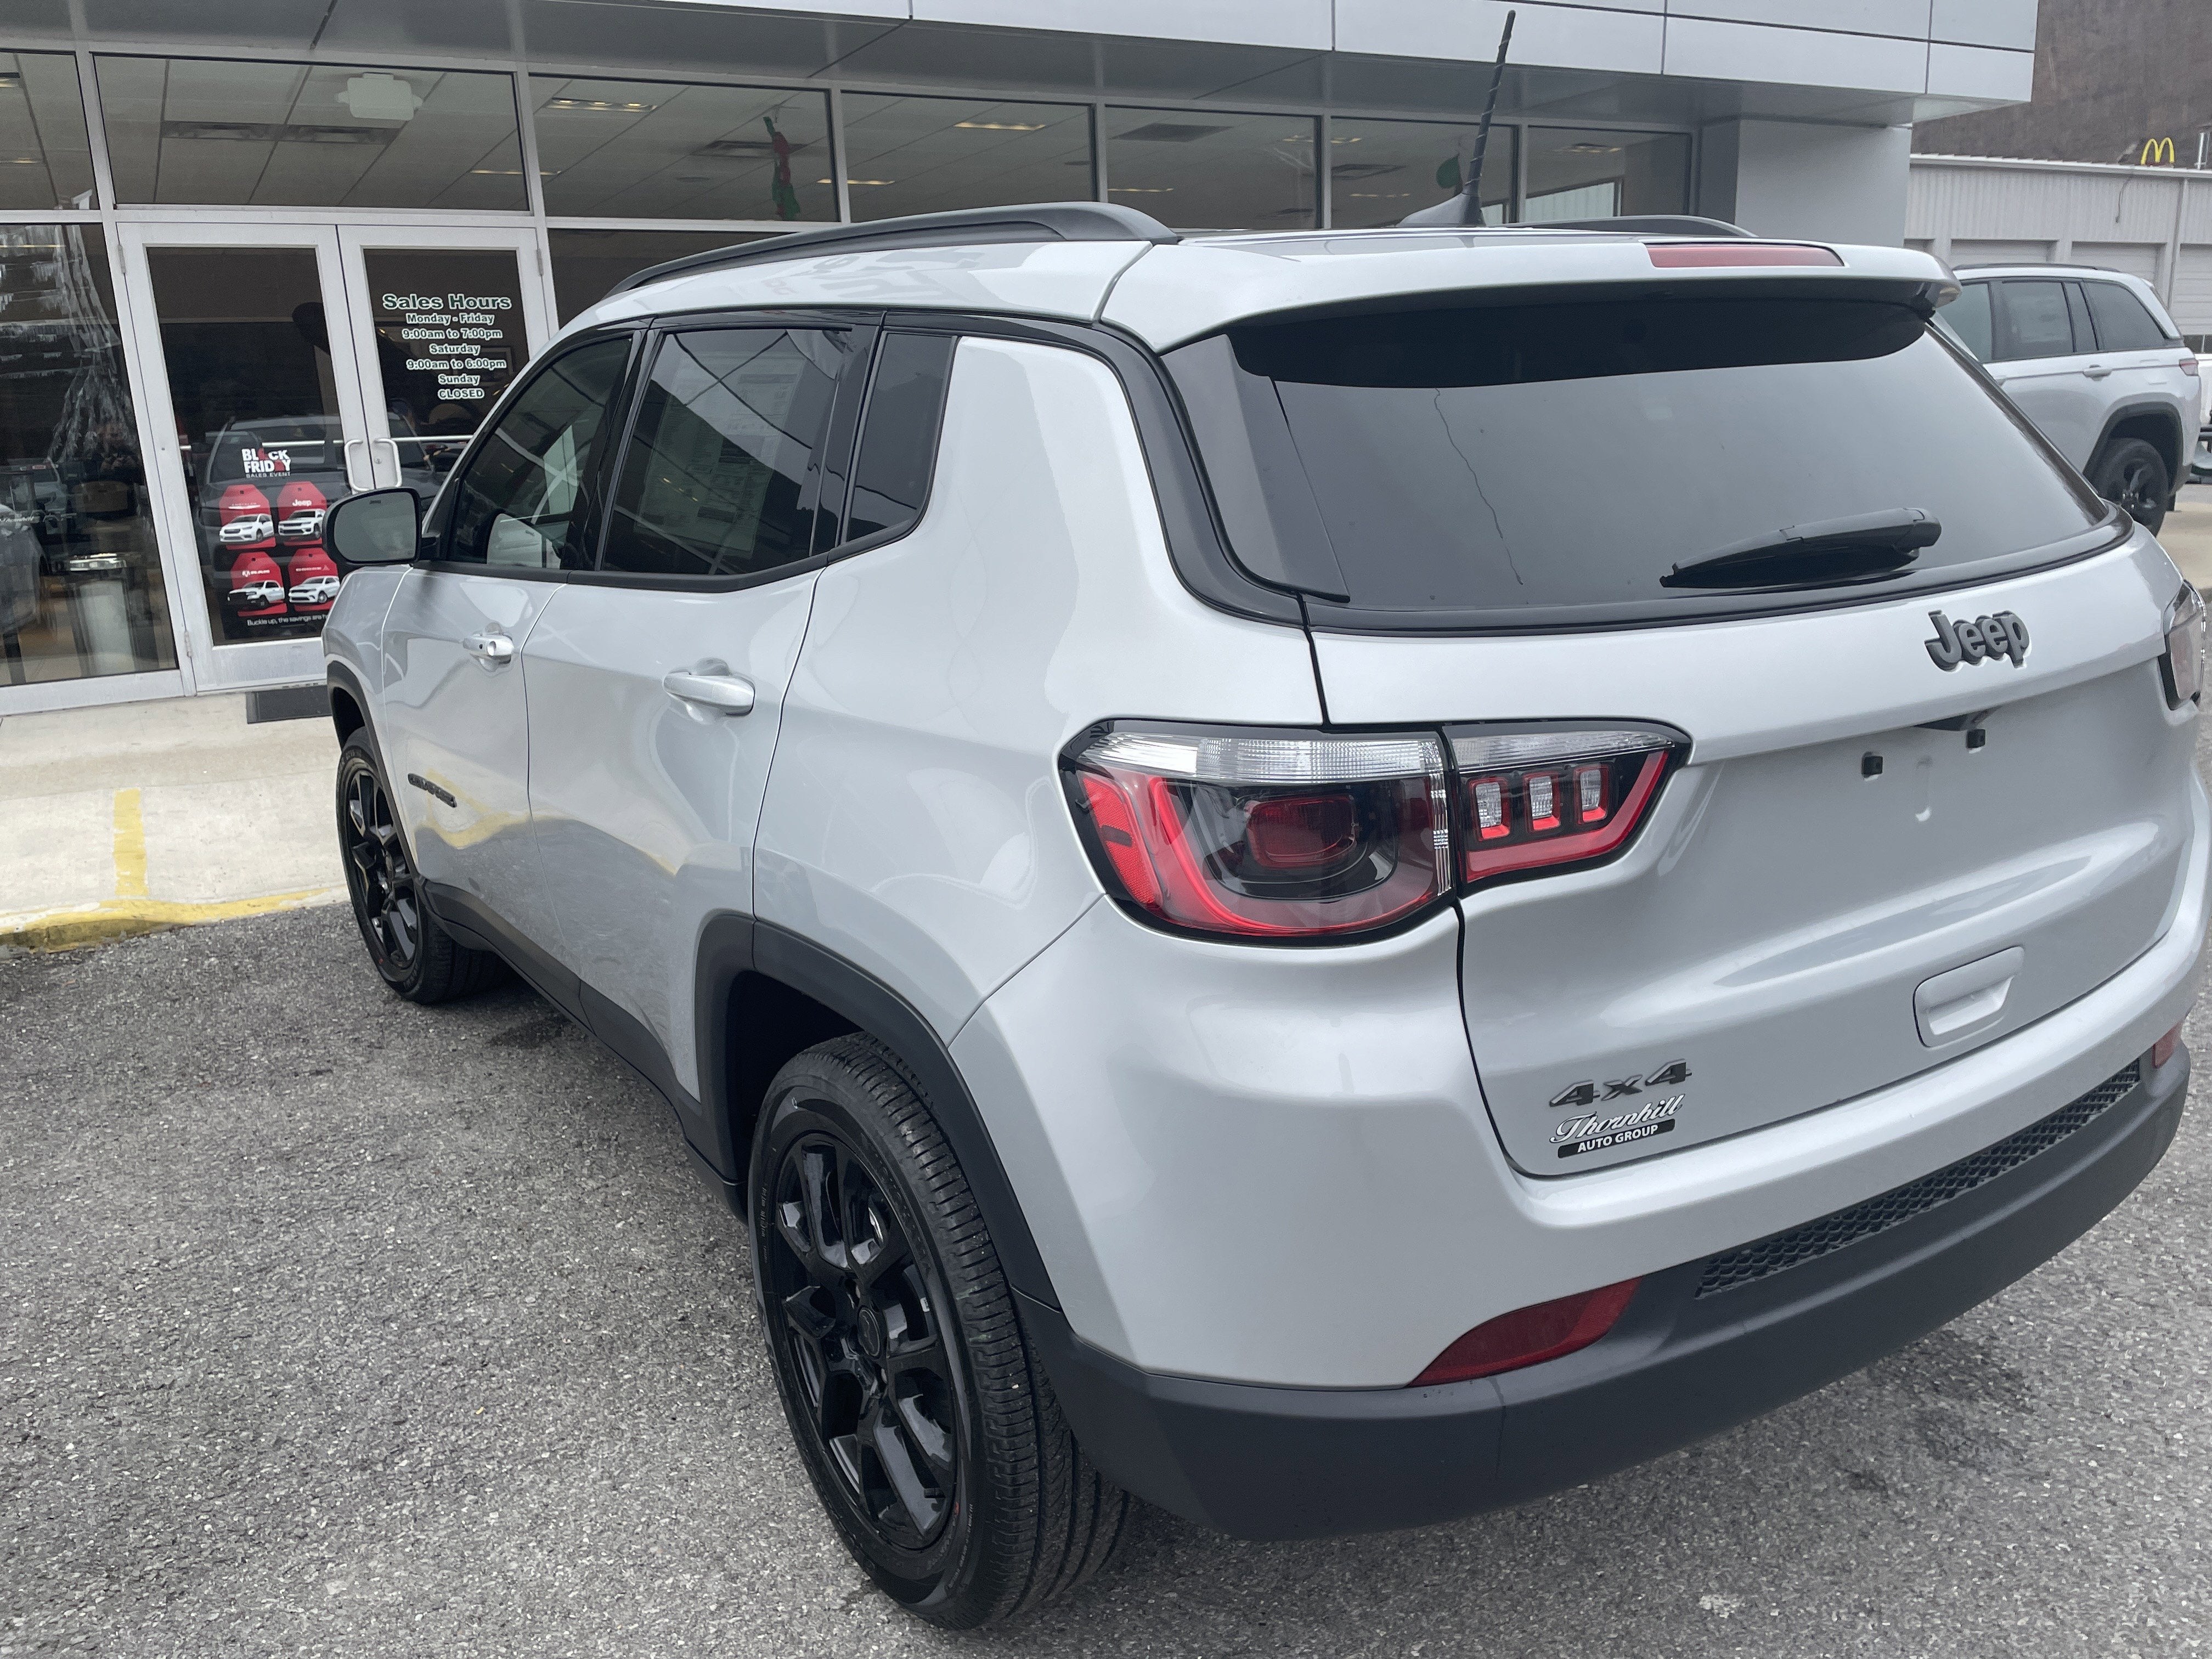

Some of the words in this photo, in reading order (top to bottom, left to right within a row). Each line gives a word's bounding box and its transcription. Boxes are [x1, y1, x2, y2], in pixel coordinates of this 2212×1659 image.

[383, 294, 443, 309] Sales
[448, 294, 512, 309] Hours
[406, 313, 451, 325] Monday
[459, 313, 494, 325] Friday
[402, 329, 445, 339] 9:00am
[447, 329, 460, 339] to
[460, 329, 503, 340] 7:00pm
[429, 343, 481, 356] Saturday
[406, 359, 449, 370] 9:00am
[450, 359, 464, 370] to
[465, 359, 507, 370] 6:00pm
[438, 374, 480, 386] Sunday
[438, 388, 484, 399] CLOSED
[1924, 610, 2030, 672] Jeep
[1549, 1058, 1692, 1107] 4x4
[1549, 1093, 1685, 1143] Thornhill
[1577, 1136, 1612, 1153] AUTO
[1615, 1125, 1658, 1143] GROUP
